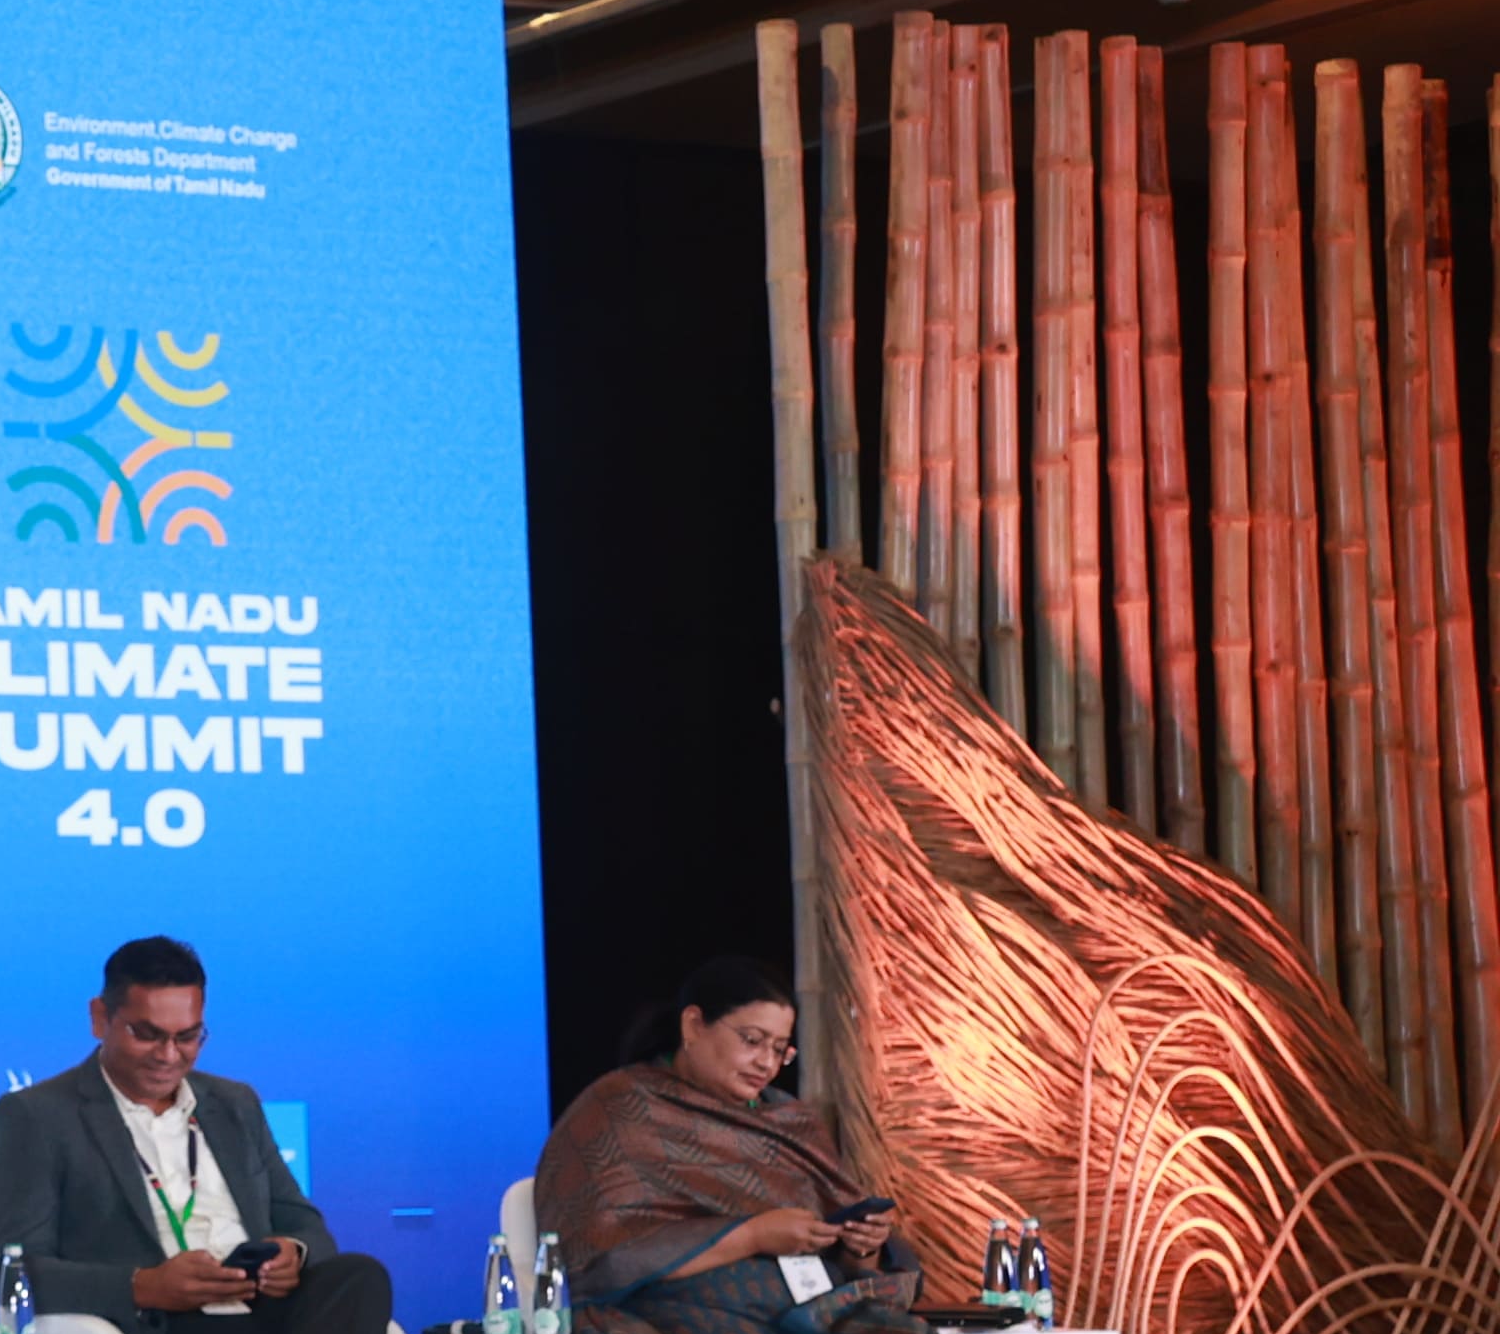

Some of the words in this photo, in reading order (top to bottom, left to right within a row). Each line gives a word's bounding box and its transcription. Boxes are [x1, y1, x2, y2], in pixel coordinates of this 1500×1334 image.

[230, 126, 297, 152] Change
[45, 143, 79, 161] and
[84, 143, 150, 167] Forests
[155, 148, 256, 174] Department
[46, 167, 150, 192] Government
[152, 174, 172, 192] of
[175, 176, 218, 195] Tamil
[222, 179, 266, 198] Nadu
[142, 591, 318, 635] NADU
[57, 788, 206, 848] 4.0
